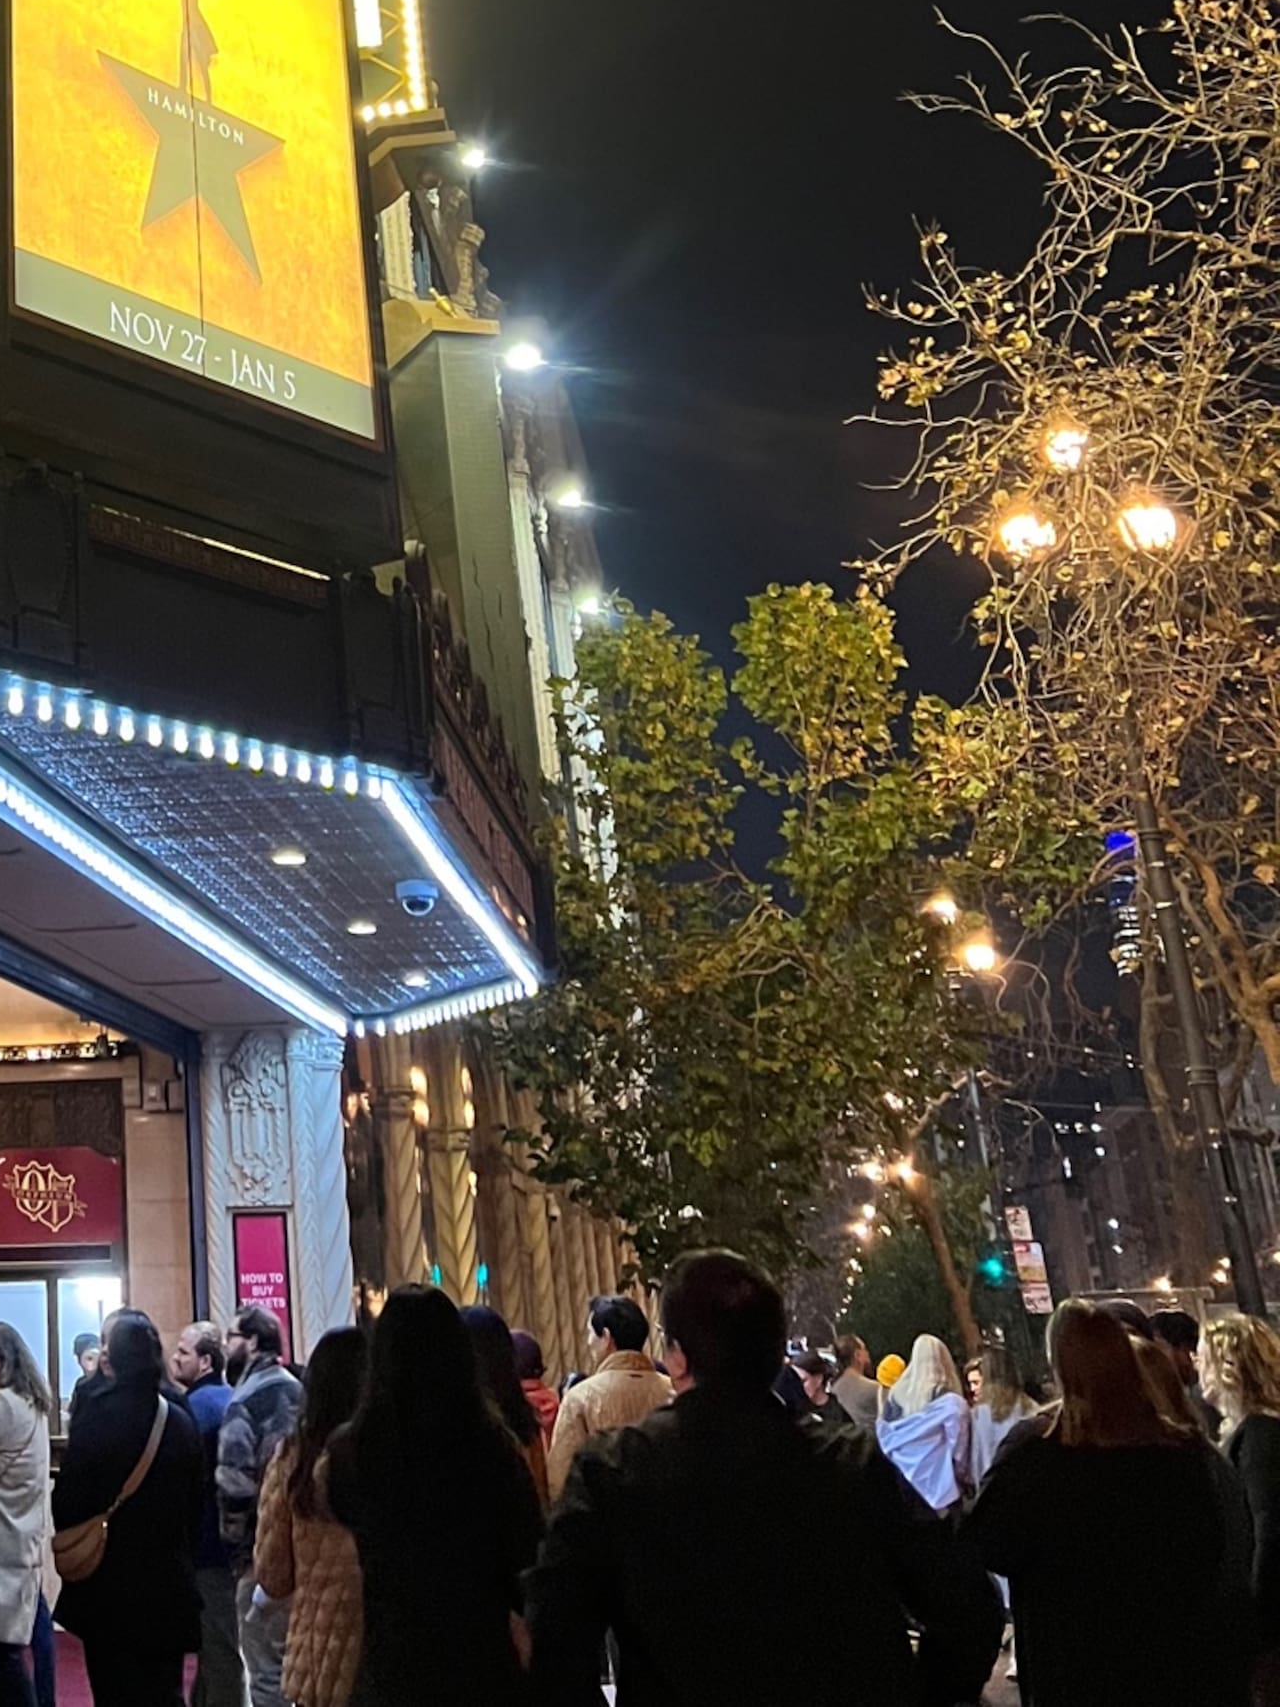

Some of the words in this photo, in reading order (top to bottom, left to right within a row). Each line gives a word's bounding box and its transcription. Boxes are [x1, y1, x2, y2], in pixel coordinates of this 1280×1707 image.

[147, 87, 244, 145] HAMILTON
[110, 301, 174, 351] NOV
[181, 329, 207, 365] 27
[231, 348, 275, 393] JAN
[284, 370, 296, 400] 5
[241, 1273, 267, 1284] HOW
[269, 1272, 284, 1284] TO
[252, 1285, 274, 1296] BUY
